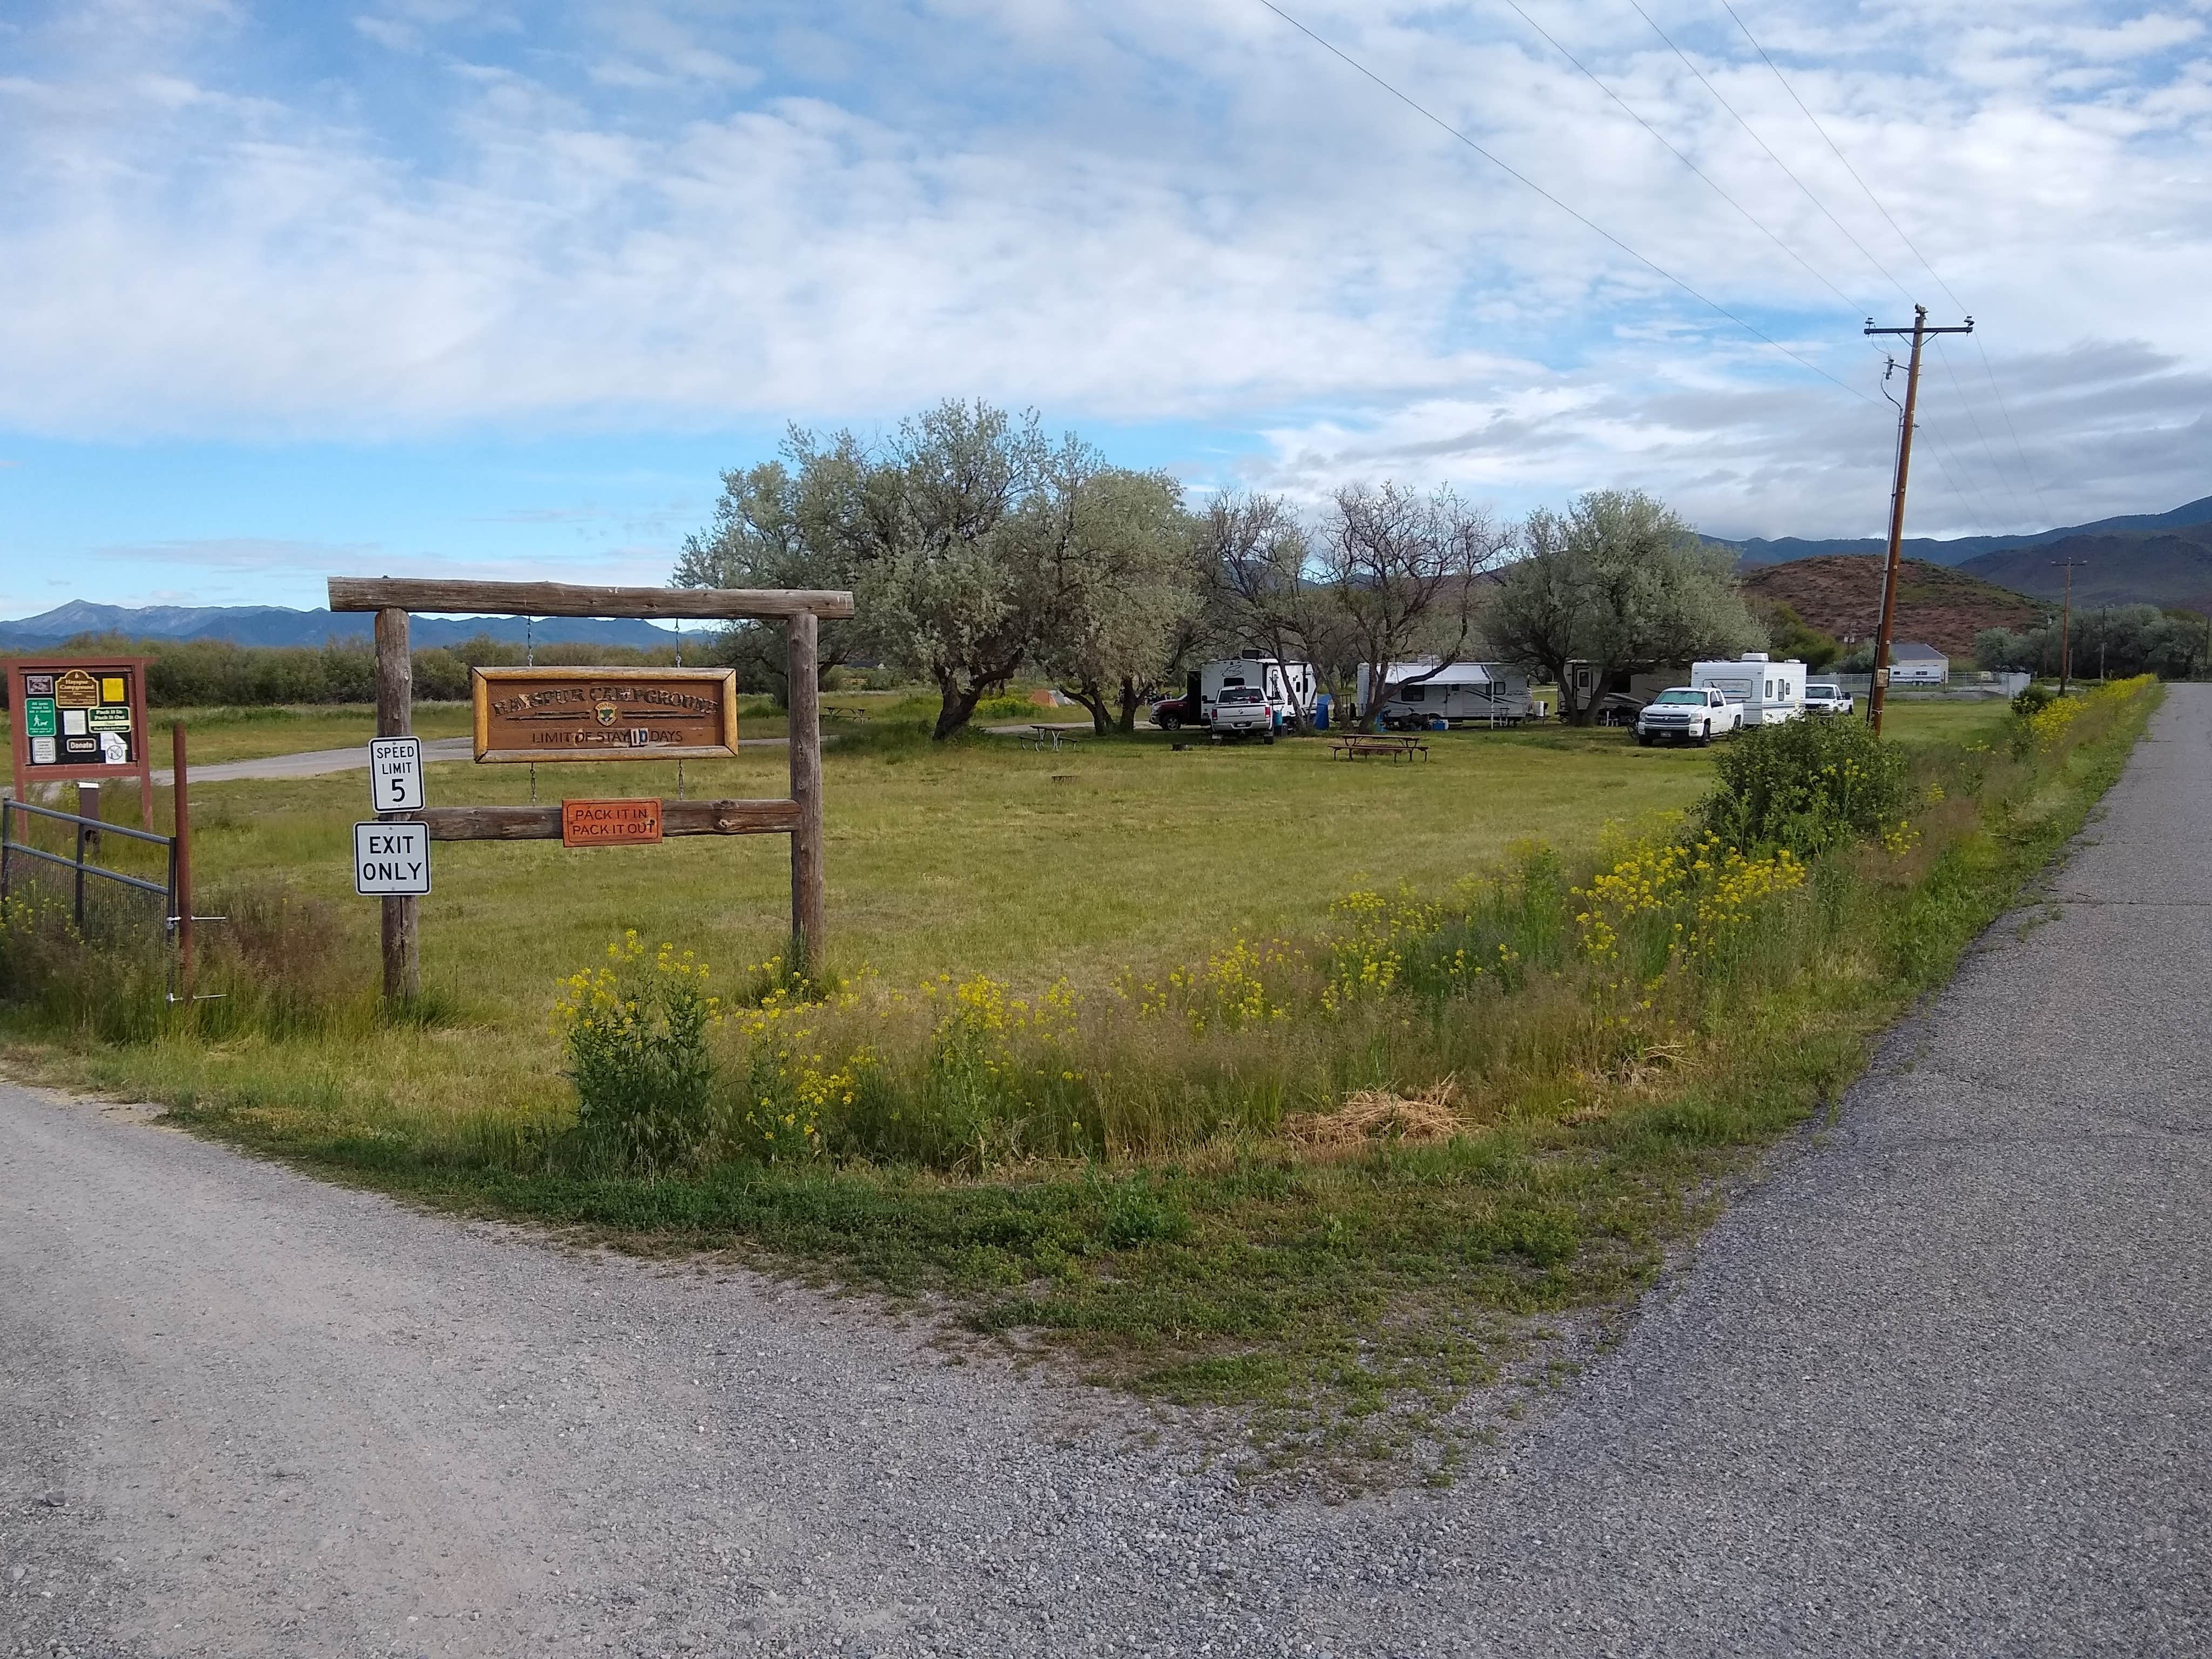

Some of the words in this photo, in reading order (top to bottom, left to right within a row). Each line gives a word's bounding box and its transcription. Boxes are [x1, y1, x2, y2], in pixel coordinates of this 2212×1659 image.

[532, 732, 573, 743] LIMIT
[575, 731, 595, 743] OF
[596, 731, 630, 743] STAY
[632, 730, 648, 745] 10
[651, 731, 683, 743] DAYS
[376, 746, 414, 759] SPEED
[382, 762, 412, 774] LIMIT
[392, 778, 406, 802] 5
[576, 810, 613, 820] PACK
[617, 809, 629, 819] IT
[633, 808, 647, 819] IN
[572, 824, 609, 835] PACK
[613, 824, 624, 834] IT
[628, 822, 656, 833] OUT
[369, 836, 414, 854] EXIT
[362, 862, 422, 881] ONLY
